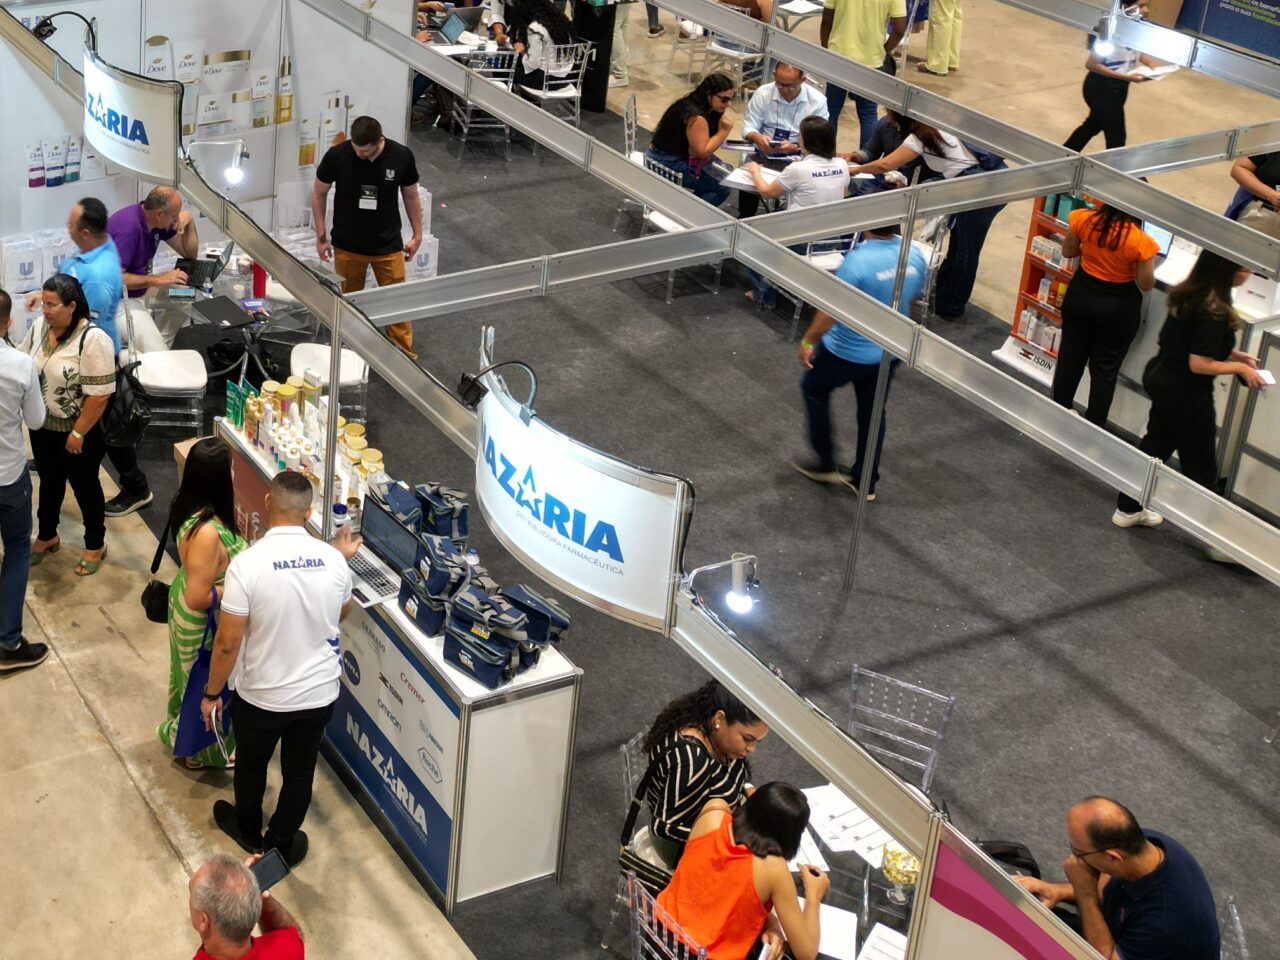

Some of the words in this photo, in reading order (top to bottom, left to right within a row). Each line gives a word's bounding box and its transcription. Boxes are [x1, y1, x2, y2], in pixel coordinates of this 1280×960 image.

[147, 65, 166, 74] Dove
[179, 60, 196, 68] Dove
[209, 67, 223, 75] Dove
[84, 92, 150, 146] ZARIA
[30, 151, 43, 159] Dov
[47, 150, 62, 158] Dove
[811, 166, 844, 179] NAZARIA
[1032, 353, 1054, 371] ISDIN
[516, 510, 562, 548] DISRIBUIDORA
[563, 544, 624, 576] FARMACÊUTICA
[273, 555, 325, 570] NAZARIA
[344, 658, 360, 680] NIVEA
[400, 672, 426, 704] Cremer
[377, 698, 402, 733] omron
[346, 712, 429, 836] NAZARIA
[422, 752, 441, 781] Roche
